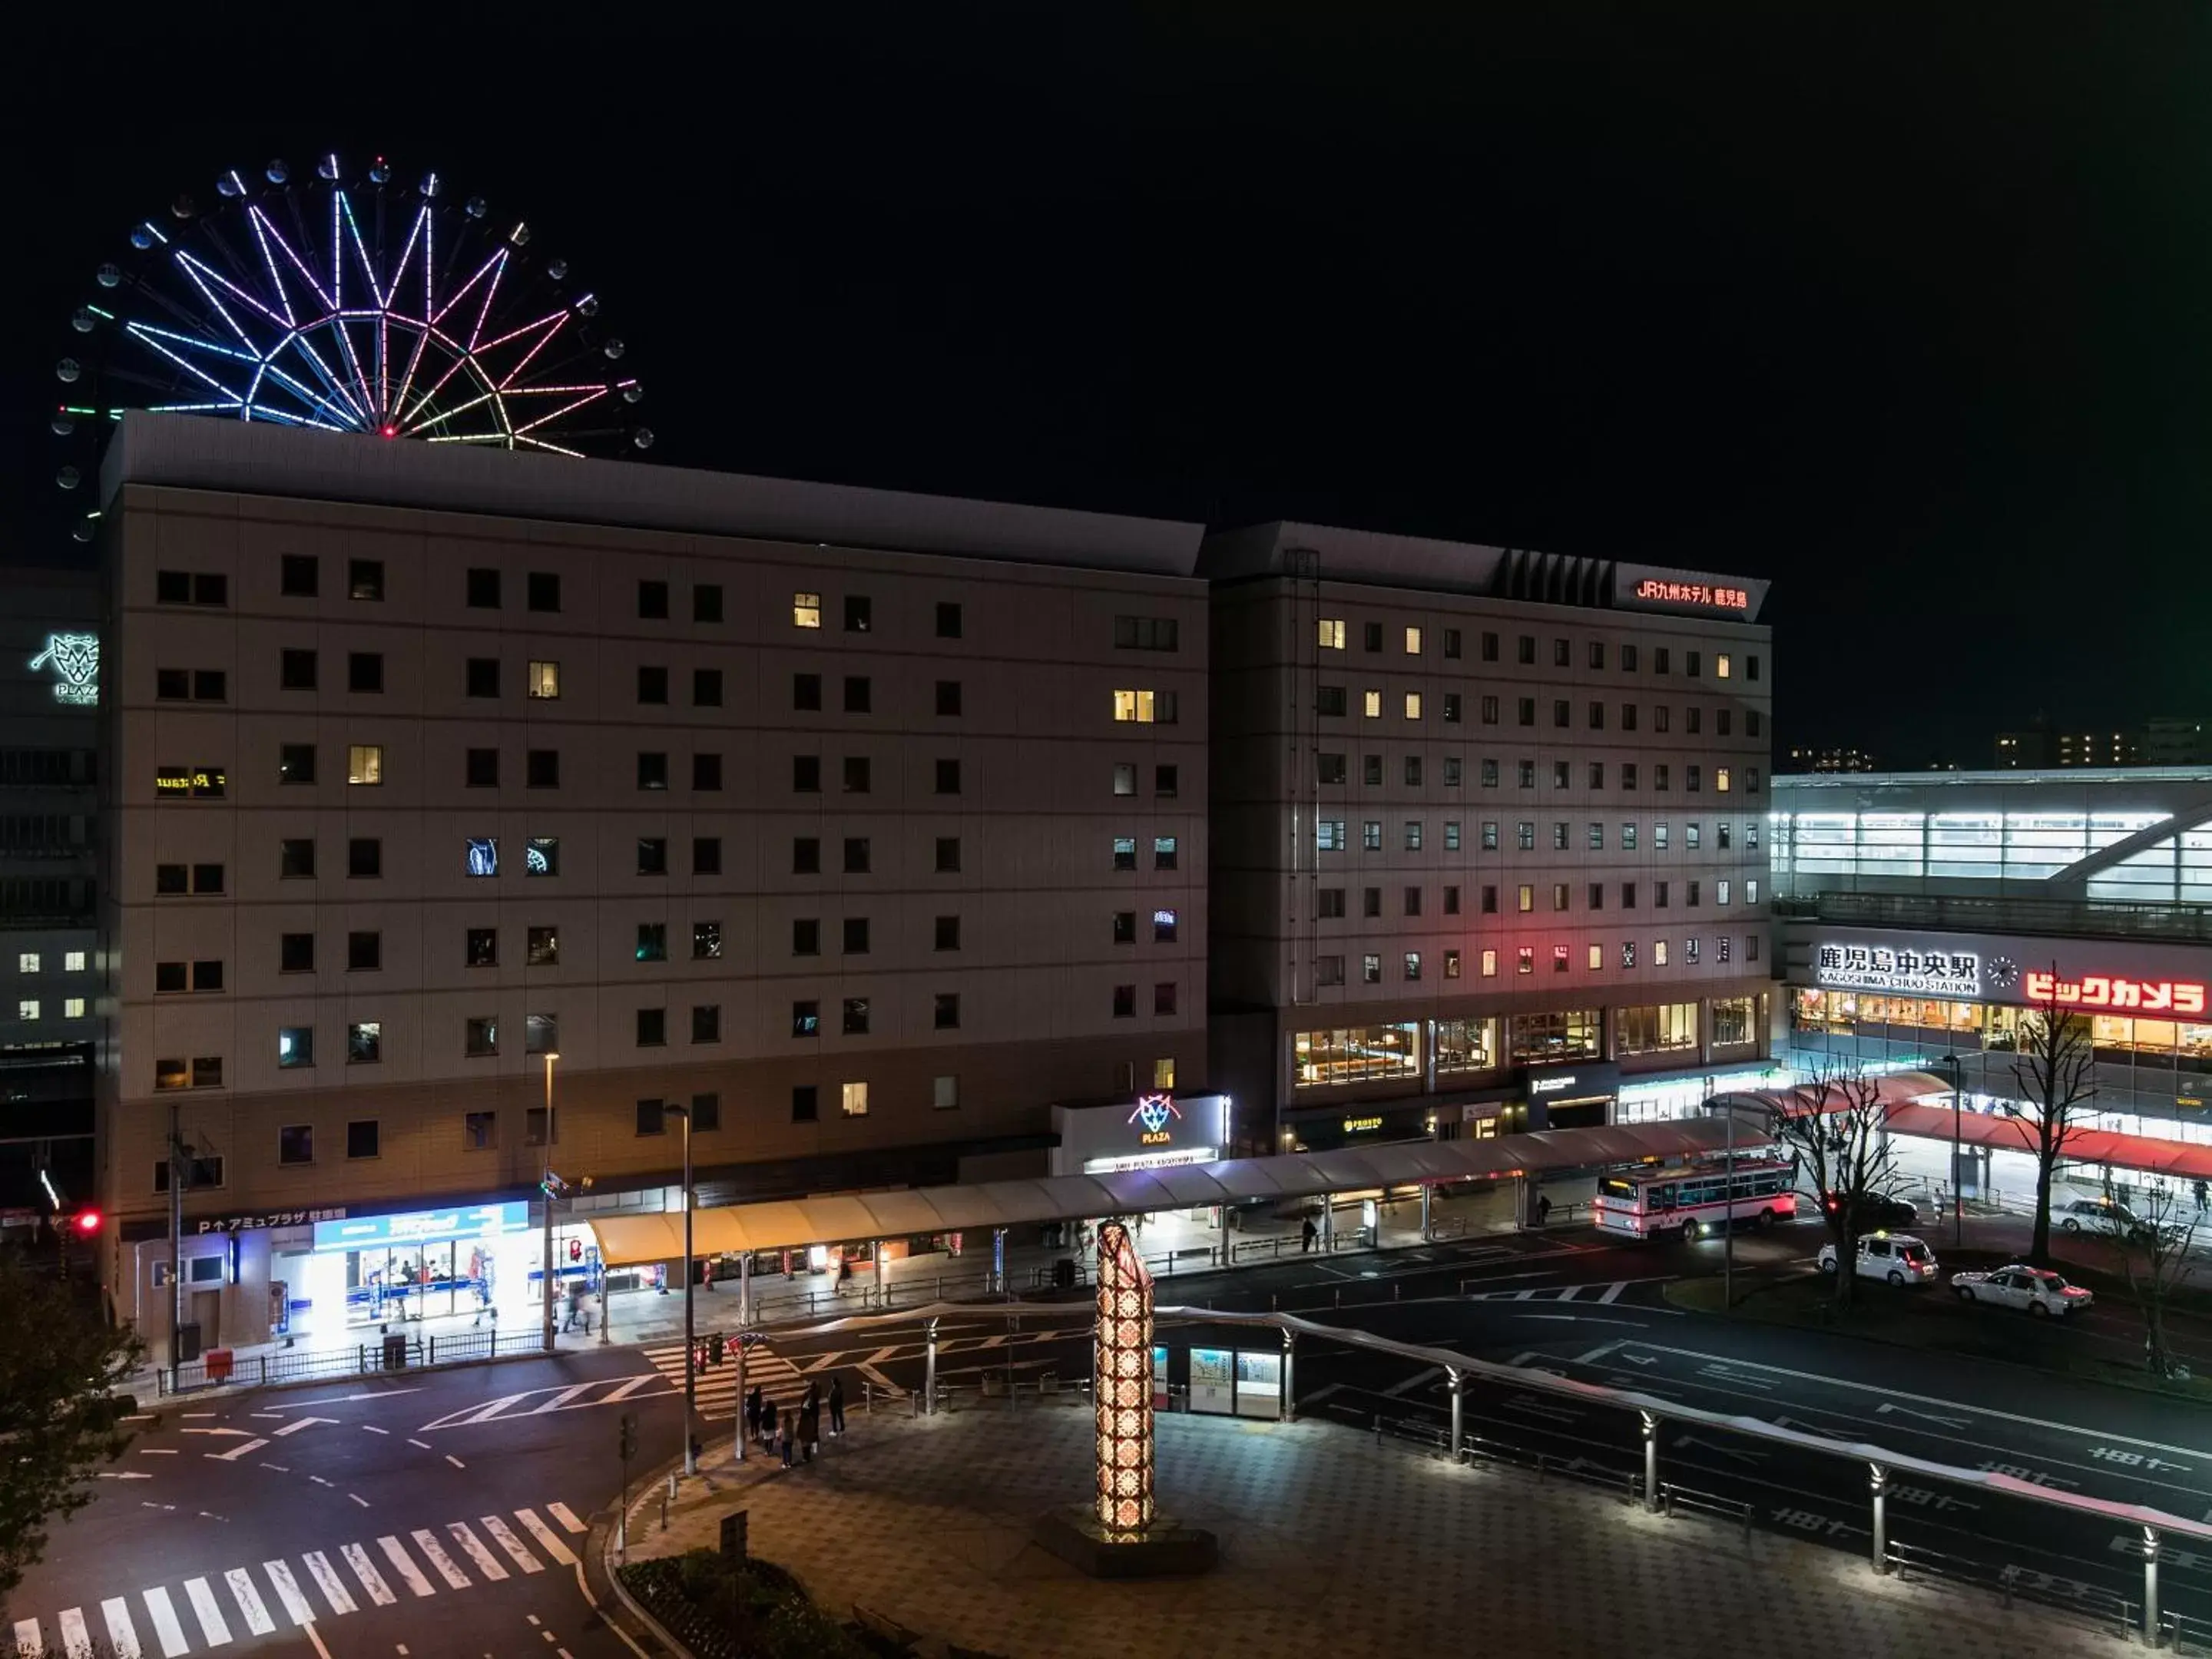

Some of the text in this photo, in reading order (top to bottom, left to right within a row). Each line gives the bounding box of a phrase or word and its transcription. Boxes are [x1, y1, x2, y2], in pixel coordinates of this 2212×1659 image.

[1637, 581, 1747, 608] JR九州ホテル 鹿児島
[1820, 945, 1977, 979] 鹿児島中央駅
[1926, 979, 1977, 994] STATION
[2026, 972, 2204, 1012] ビックカメラ
[1353, 1117, 1382, 1128] PRONTO
[1142, 1131, 1171, 1144] PLAZA
[198, 1221, 210, 1233] P
[229, 1211, 306, 1230] アミュプラザ
